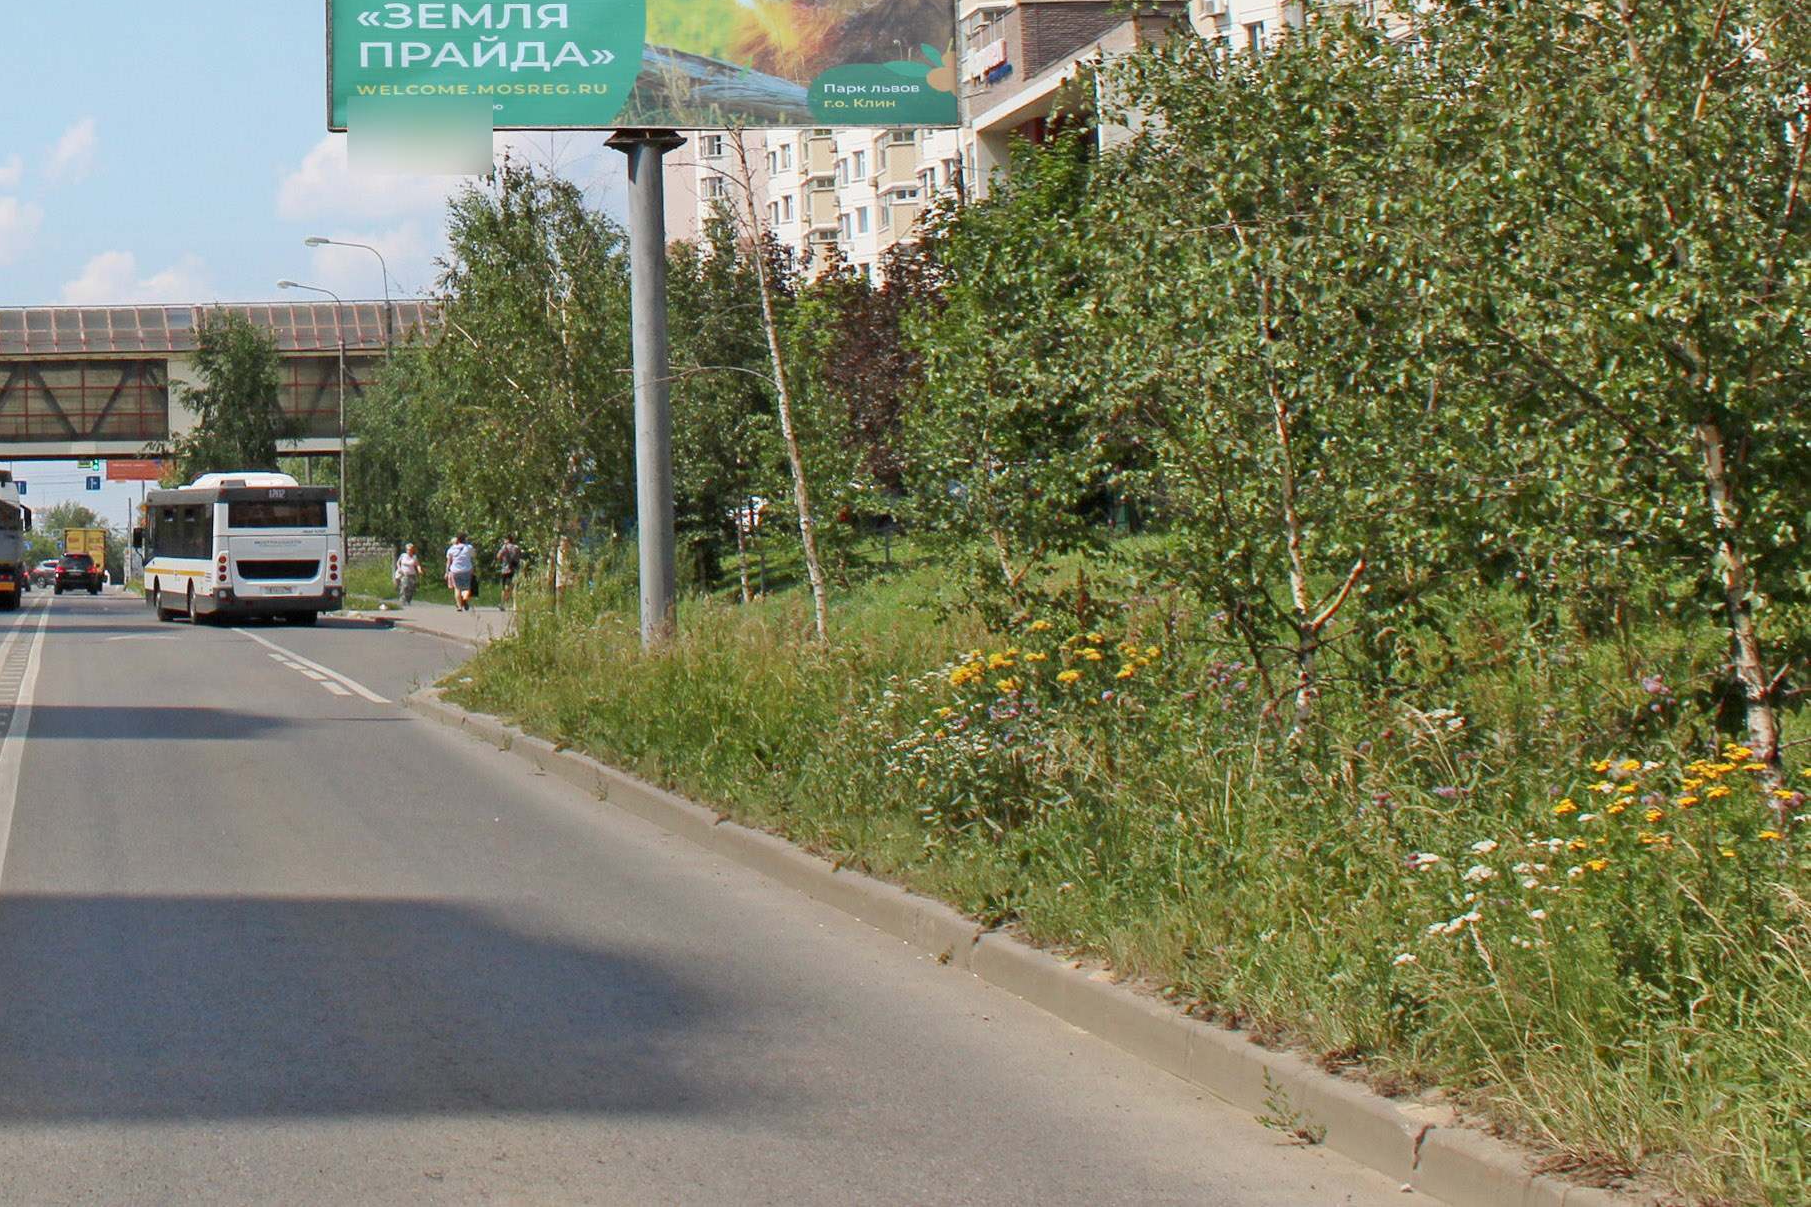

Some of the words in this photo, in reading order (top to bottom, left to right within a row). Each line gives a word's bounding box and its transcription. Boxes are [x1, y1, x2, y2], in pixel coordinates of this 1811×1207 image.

[356, 3, 568, 30] «ЗЕМЛЯ
[359, 35, 615, 72] ПРАЙДА»
[356, 83, 608, 96] WELCOME.MOSREG.RU
[823, 83, 866, 95] Парк
[870, 84, 920, 94] львов
[823, 99, 849, 108] г.о.
[853, 98, 896, 109] Клин
